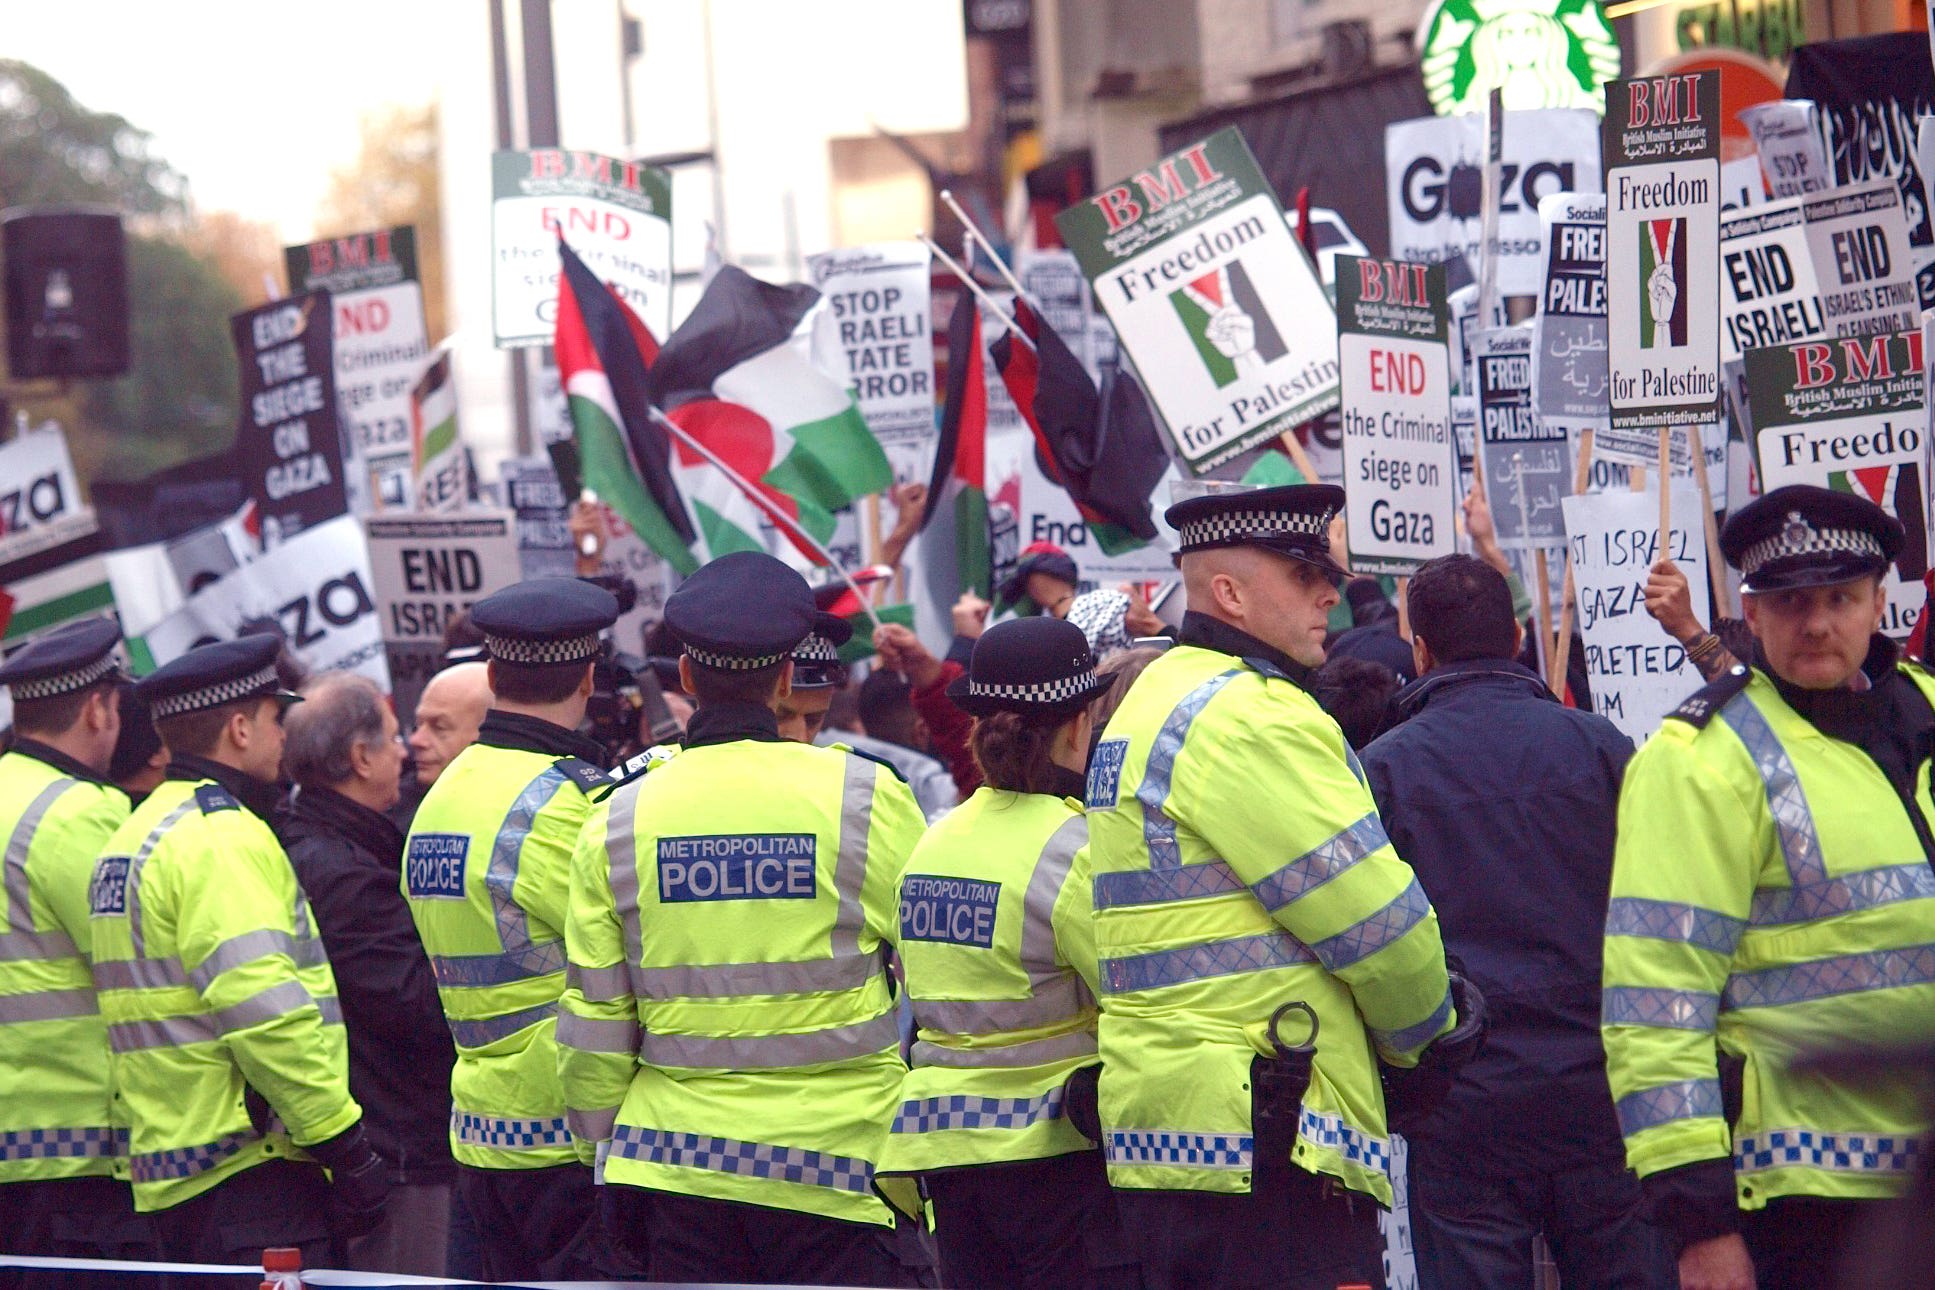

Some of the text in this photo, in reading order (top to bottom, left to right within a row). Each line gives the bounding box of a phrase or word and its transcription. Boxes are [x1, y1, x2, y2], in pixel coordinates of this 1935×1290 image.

[1626, 74, 1702, 128] BMI
[1646, 128, 1673, 142] Muslim
[1674, 125, 1707, 141] Initiative
[531, 150, 643, 193] BMI
[1092, 142, 1224, 236] BMI
[1618, 171, 1708, 211] Freedom
[541, 206, 632, 241] END
[1566, 206, 1606, 221] Sociali
[310, 230, 391, 275] BMI
[1115, 215, 1266, 305] Freedom
[1724, 244, 1795, 303] END
[1831, 225, 1891, 285] END
[831, 287, 902, 318] STOP
[1356, 258, 1432, 309] BMI
[252, 304, 307, 350] END
[336, 297, 391, 340] ND
[840, 314, 924, 345] RAELI
[257, 341, 308, 386] THE
[846, 344, 912, 373] TATE
[1369, 348, 1426, 397] END
[1485, 358, 1531, 391] FREED
[1788, 329, 1924, 390] BMI
[252, 375, 325, 428] SIEGE
[851, 372, 929, 400] RROR
[1613, 365, 1716, 400] for Palestine
[1784, 377, 1924, 408] British Muslim Initia
[1181, 360, 1339, 452] for Palestin
[1345, 407, 1376, 437] the
[1381, 411, 1449, 445] Criminal
[1612, 410, 1717, 428] www.bminitiative.net
[272, 419, 310, 459] ON
[1778, 422, 1922, 467] Freedo
[265, 451, 333, 500] GAZA
[1360, 450, 1440, 491] siege on
[0, 473, 65, 532] za
[1370, 499, 1435, 546] Gaza
[402, 549, 482, 593] END
[1573, 534, 1588, 565] ST
[278, 570, 375, 648] za
[391, 602, 473, 636] ISRA
[1581, 582, 1647, 631] GAZA
[660, 837, 814, 859] METROPOLITAN
[409, 857, 462, 890] POLICE
[661, 858, 814, 899] POLICE
[901, 879, 998, 904] METROPOLITAN
[900, 900, 993, 943] POLICE
